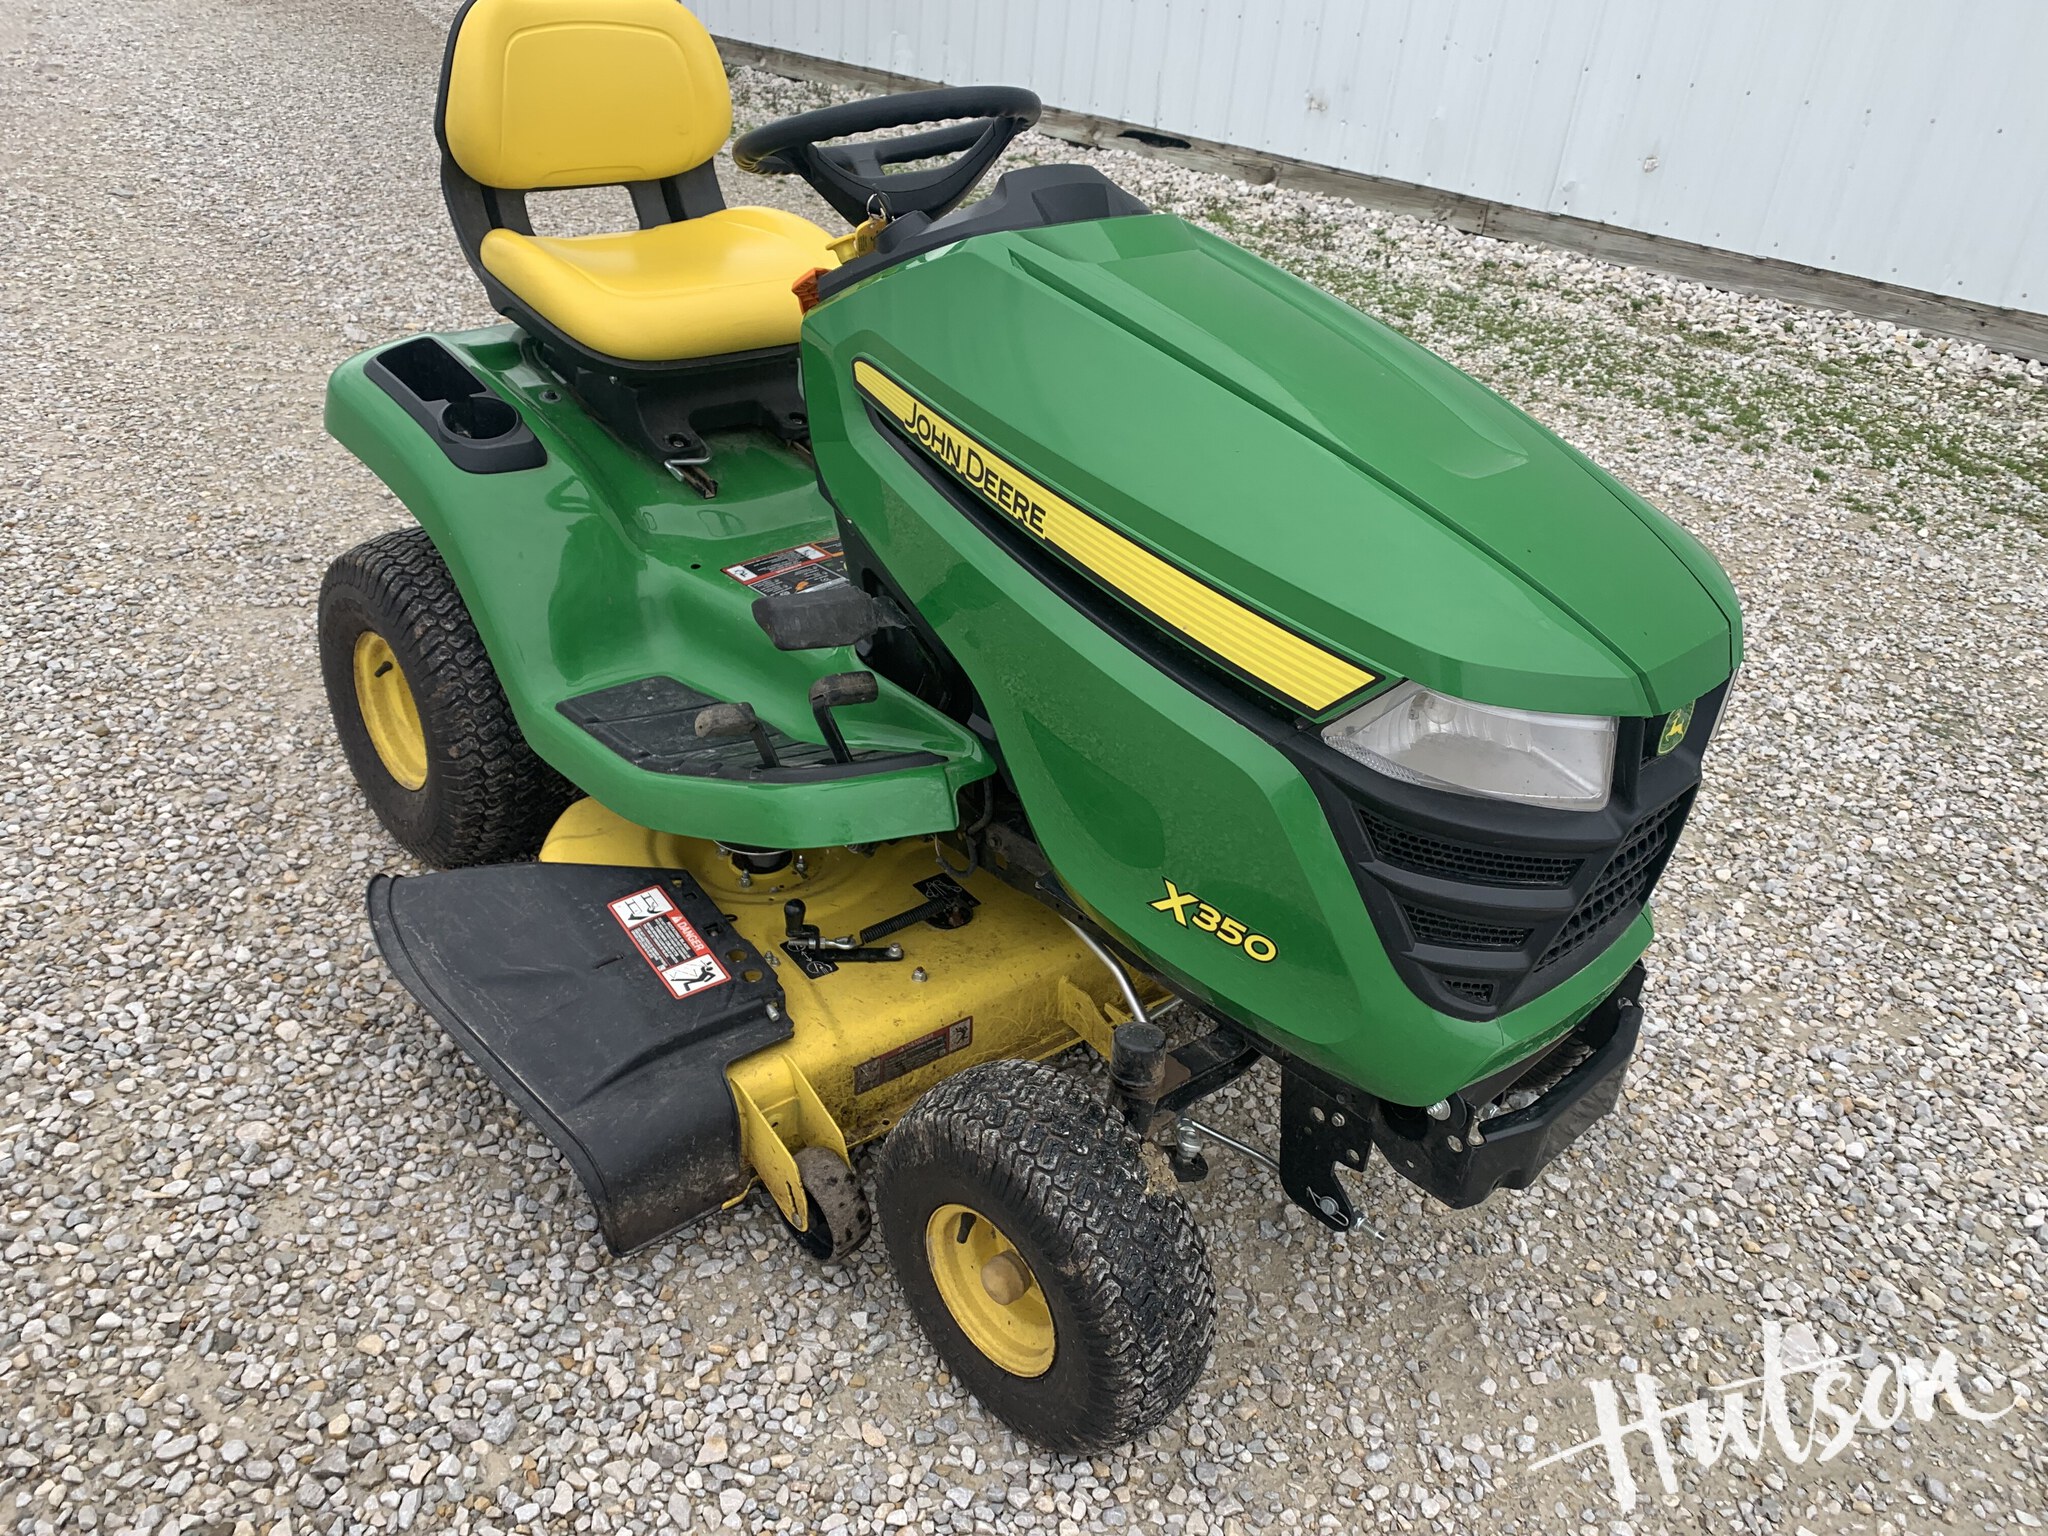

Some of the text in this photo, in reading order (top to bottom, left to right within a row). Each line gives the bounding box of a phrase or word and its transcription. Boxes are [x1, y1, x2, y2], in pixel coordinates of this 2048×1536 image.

[904, 402, 1046, 535] JOHN DEERE
[678, 921, 705, 951] DANGER
[1146, 875, 1279, 964] X350
